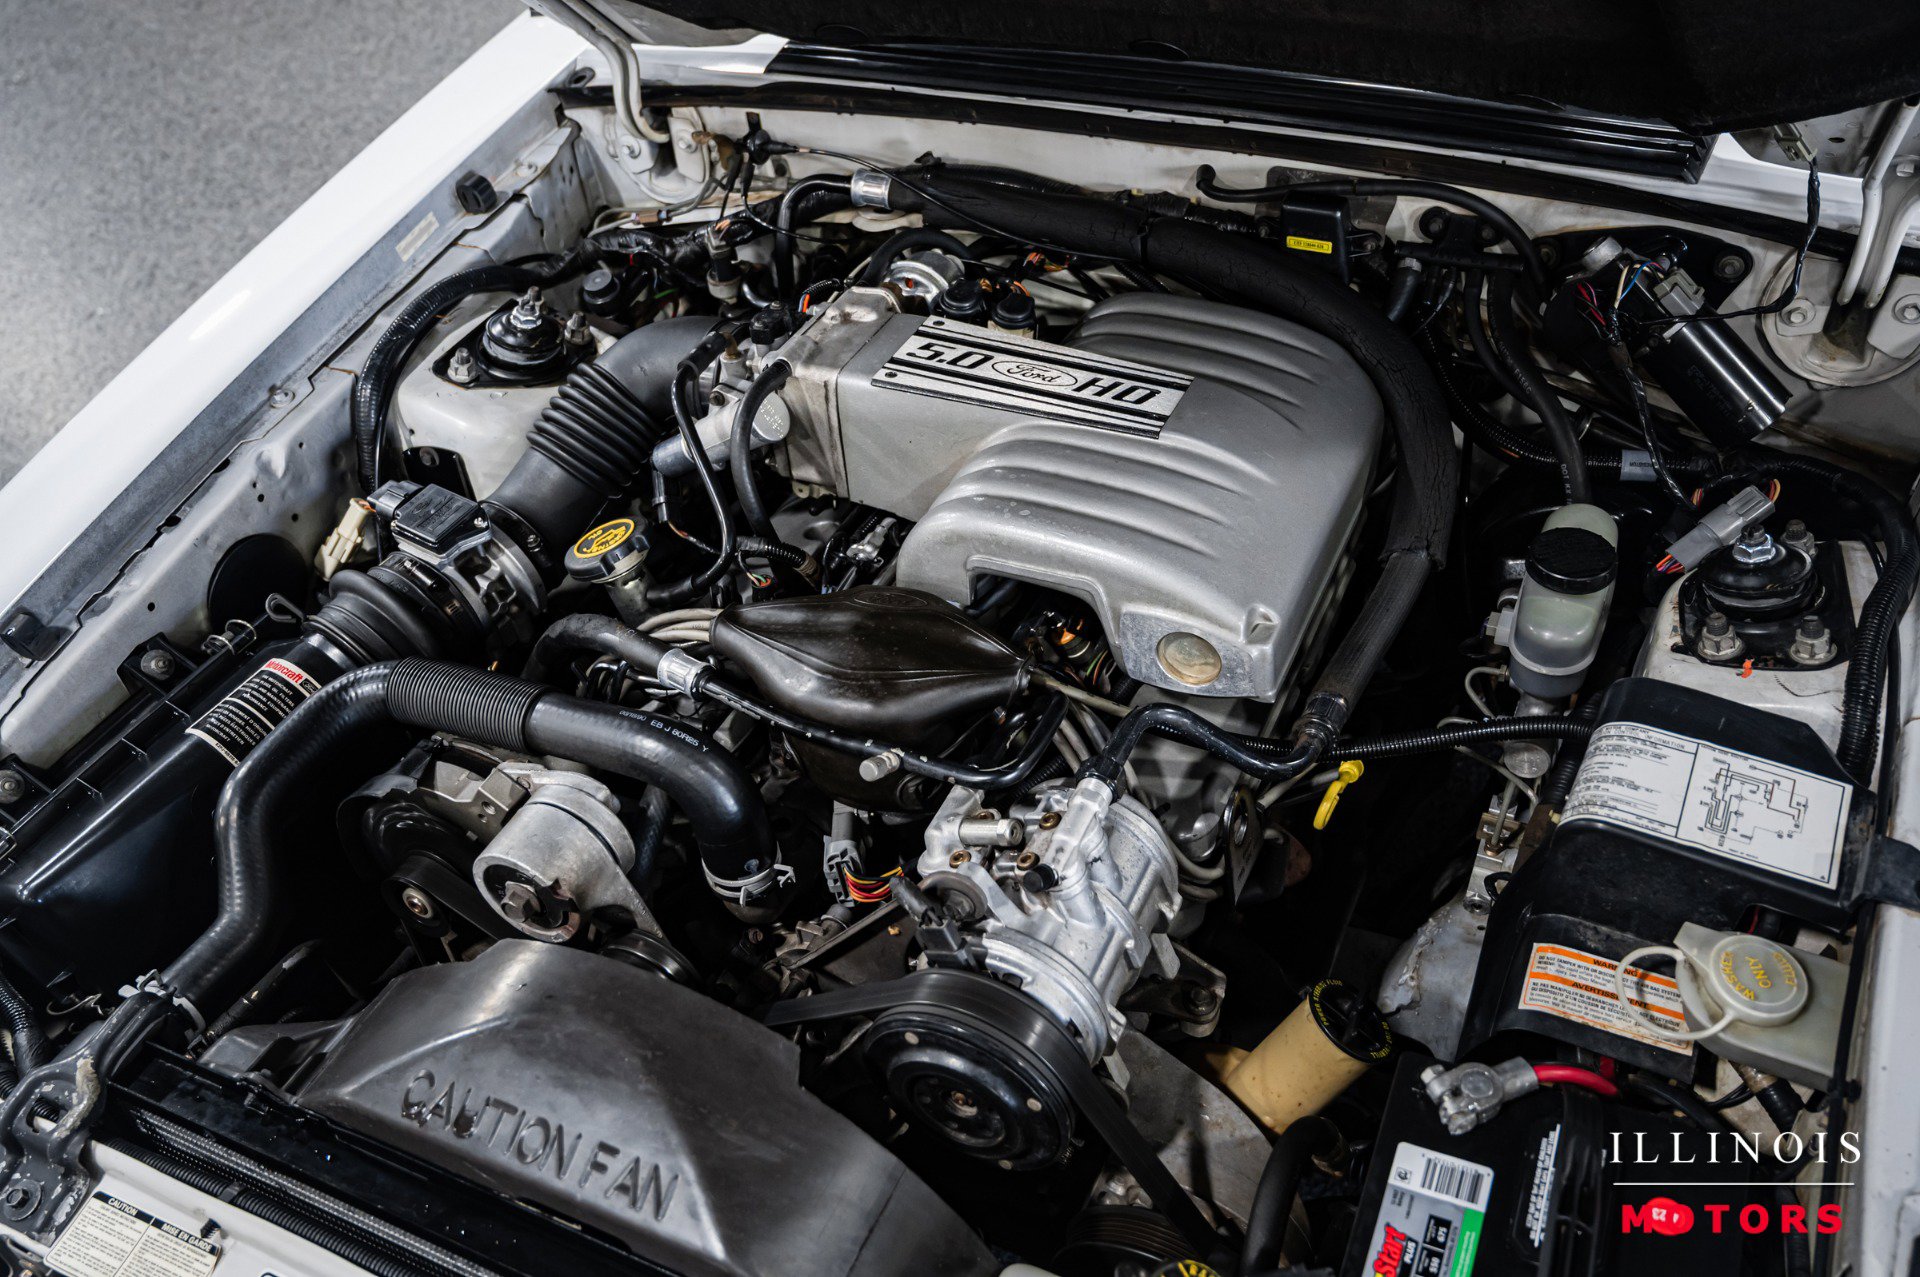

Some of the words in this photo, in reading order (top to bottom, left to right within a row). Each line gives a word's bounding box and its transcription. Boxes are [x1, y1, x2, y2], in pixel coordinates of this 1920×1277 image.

[906, 342, 994, 370] 5.0
[1006, 363, 1056, 385] Ford
[1074, 377, 1162, 405] HO
[265, 660, 303, 684] Motorcraft
[1645, 734, 1685, 750] INFORMATION
[1593, 958, 1638, 977] WARNG
[1720, 951, 1755, 1001] WASHER
[1745, 956, 1772, 989] ONLY
[402, 1068, 582, 1180] CAUTION
[578, 1140, 680, 1222] FAN
[108, 1197, 138, 1216] CAUTION
[161, 1223, 179, 1237] MISE
[179, 1232, 188, 1242] EN
[188, 1235, 213, 1252] GARDE
[1436, 1226, 1448, 1243] 675
[1403, 1240, 1417, 1264] PLUS
